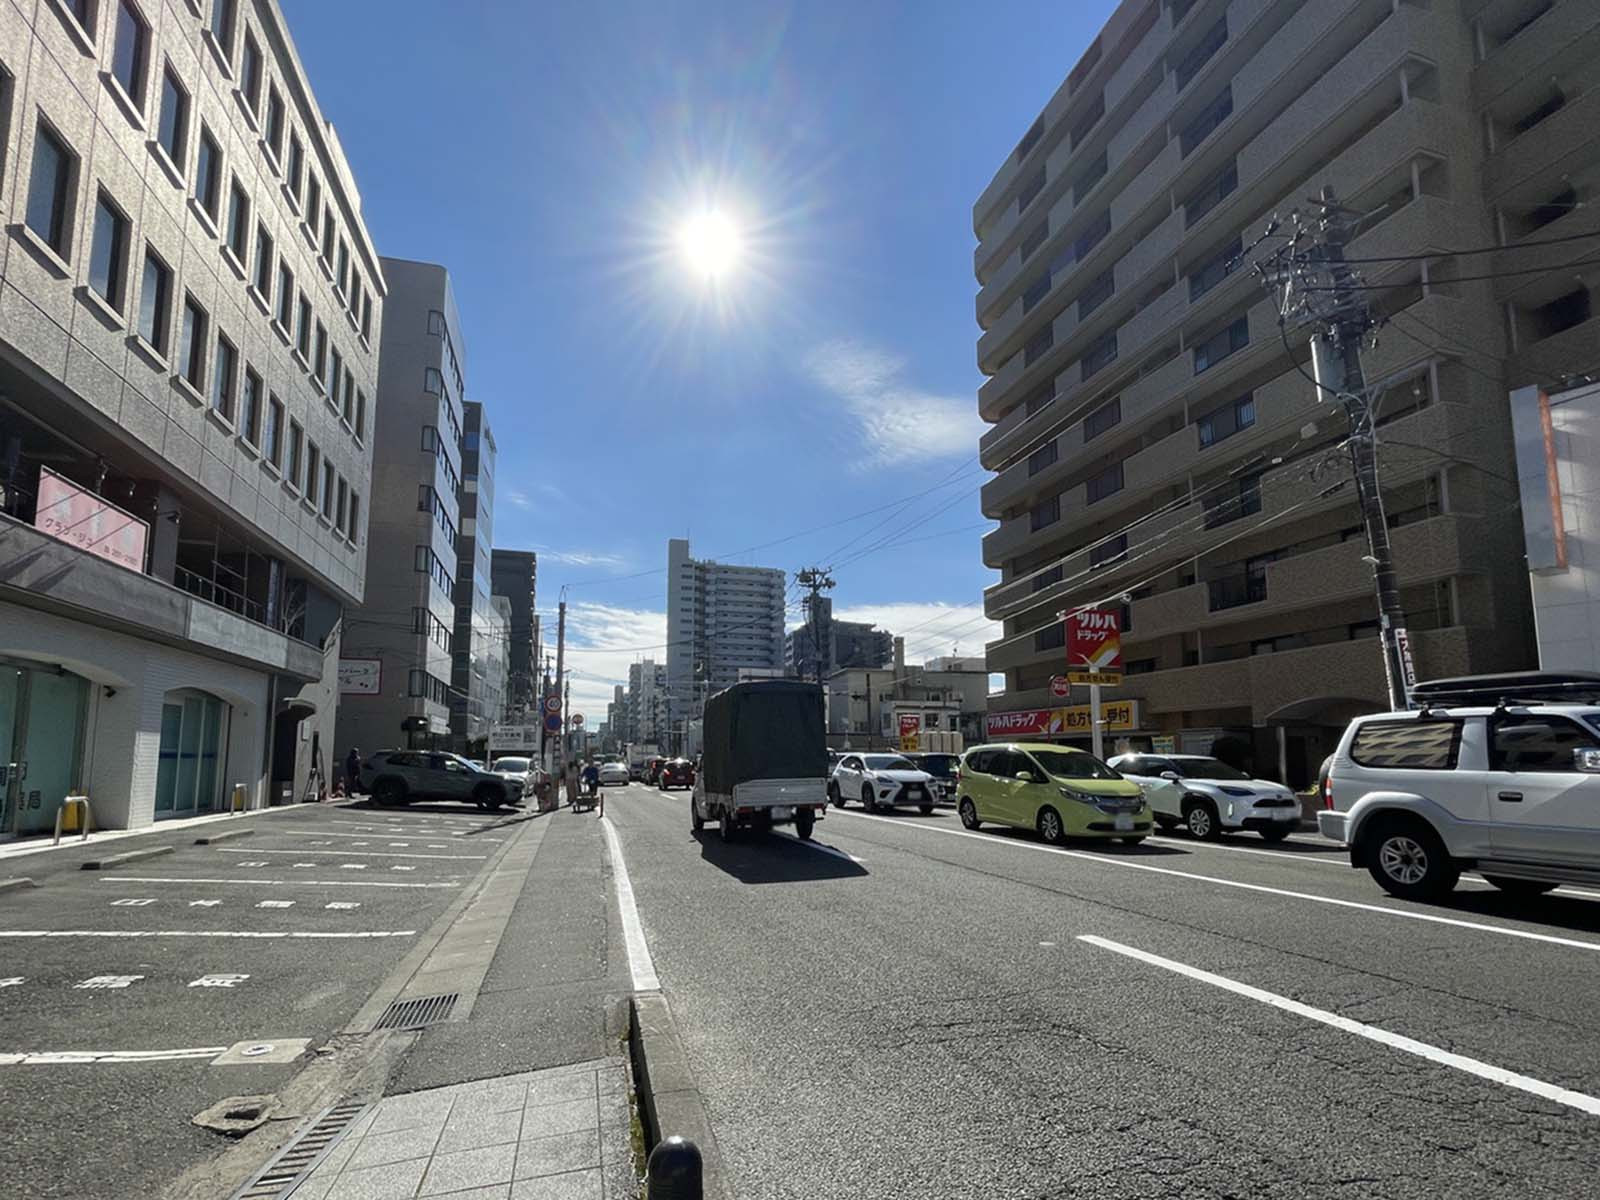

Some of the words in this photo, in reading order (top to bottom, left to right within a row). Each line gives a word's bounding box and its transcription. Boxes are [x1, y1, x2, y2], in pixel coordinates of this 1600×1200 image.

[1076, 613, 1117, 630] ツルハ
[1077, 630, 1109, 640] ドラッグ
[988, 713, 1037, 728] ツルハドラッグ
